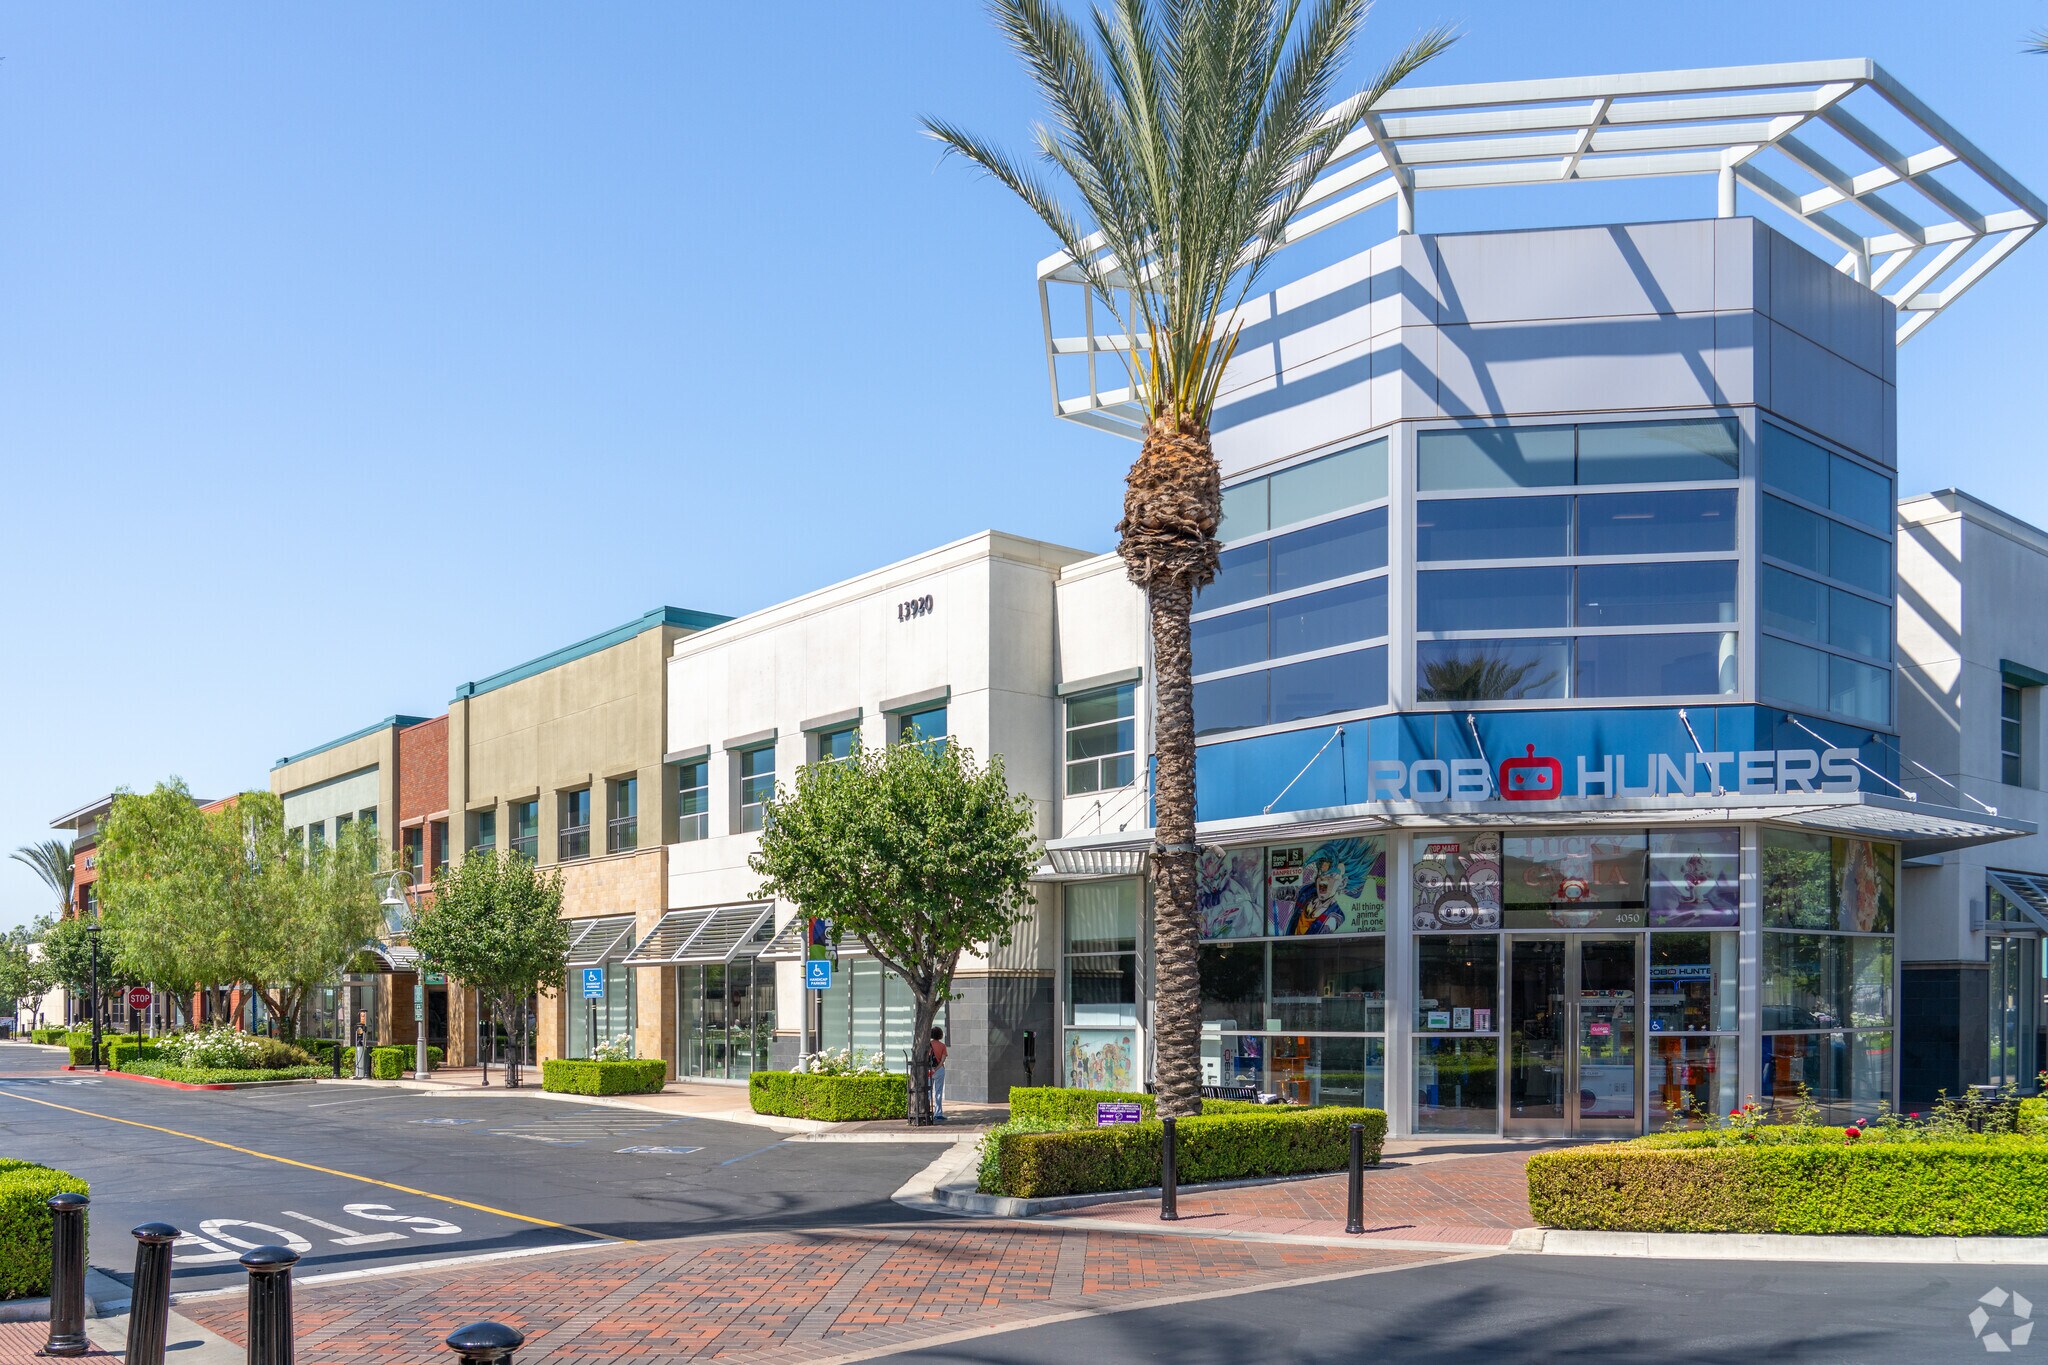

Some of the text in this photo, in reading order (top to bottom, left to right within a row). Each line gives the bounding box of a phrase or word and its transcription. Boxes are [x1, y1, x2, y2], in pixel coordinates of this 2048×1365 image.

[1577, 748, 1860, 799] HUNTERS
[1442, 845, 1459, 853] MART
[1273, 868, 1302, 876] BANPRESTO
[1351, 902, 1384, 912] All things
[1357, 910, 1378, 918] anime
[1615, 914, 1640, 923] 4050
[1351, 918, 1384, 926] All in one
[131, 994, 150, 1003] STOP
[172, 1203, 463, 1264] STOP
